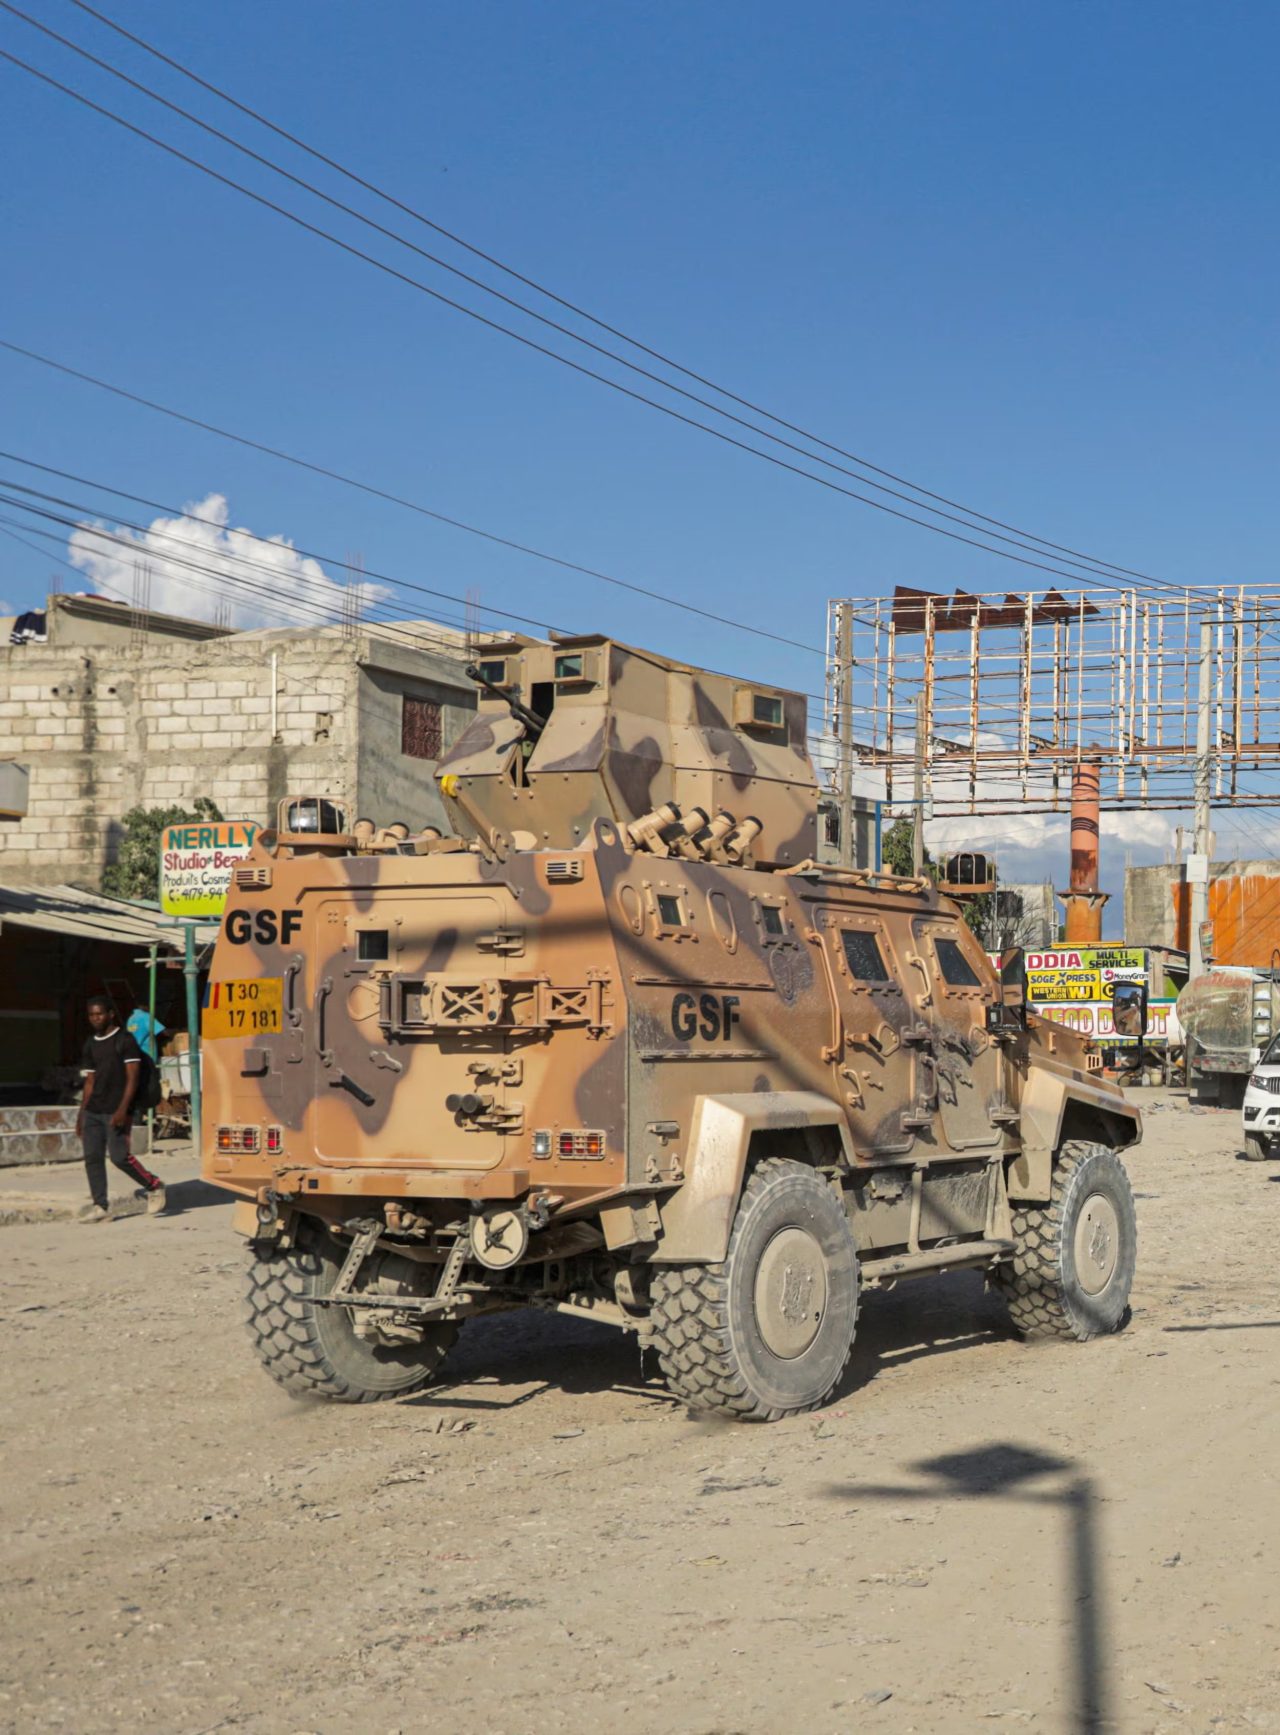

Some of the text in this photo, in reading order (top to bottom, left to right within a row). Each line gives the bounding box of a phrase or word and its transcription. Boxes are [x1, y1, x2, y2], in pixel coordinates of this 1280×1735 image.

[168, 826, 256, 850] NERLLY
[164, 852, 207, 871] Studio
[225, 909, 303, 945] GSF
[1089, 959, 1138, 968] SERVICES
[225, 983, 259, 1002] T 30
[229, 1010, 277, 1029] 17 181
[671, 993, 740, 1041] GSF
